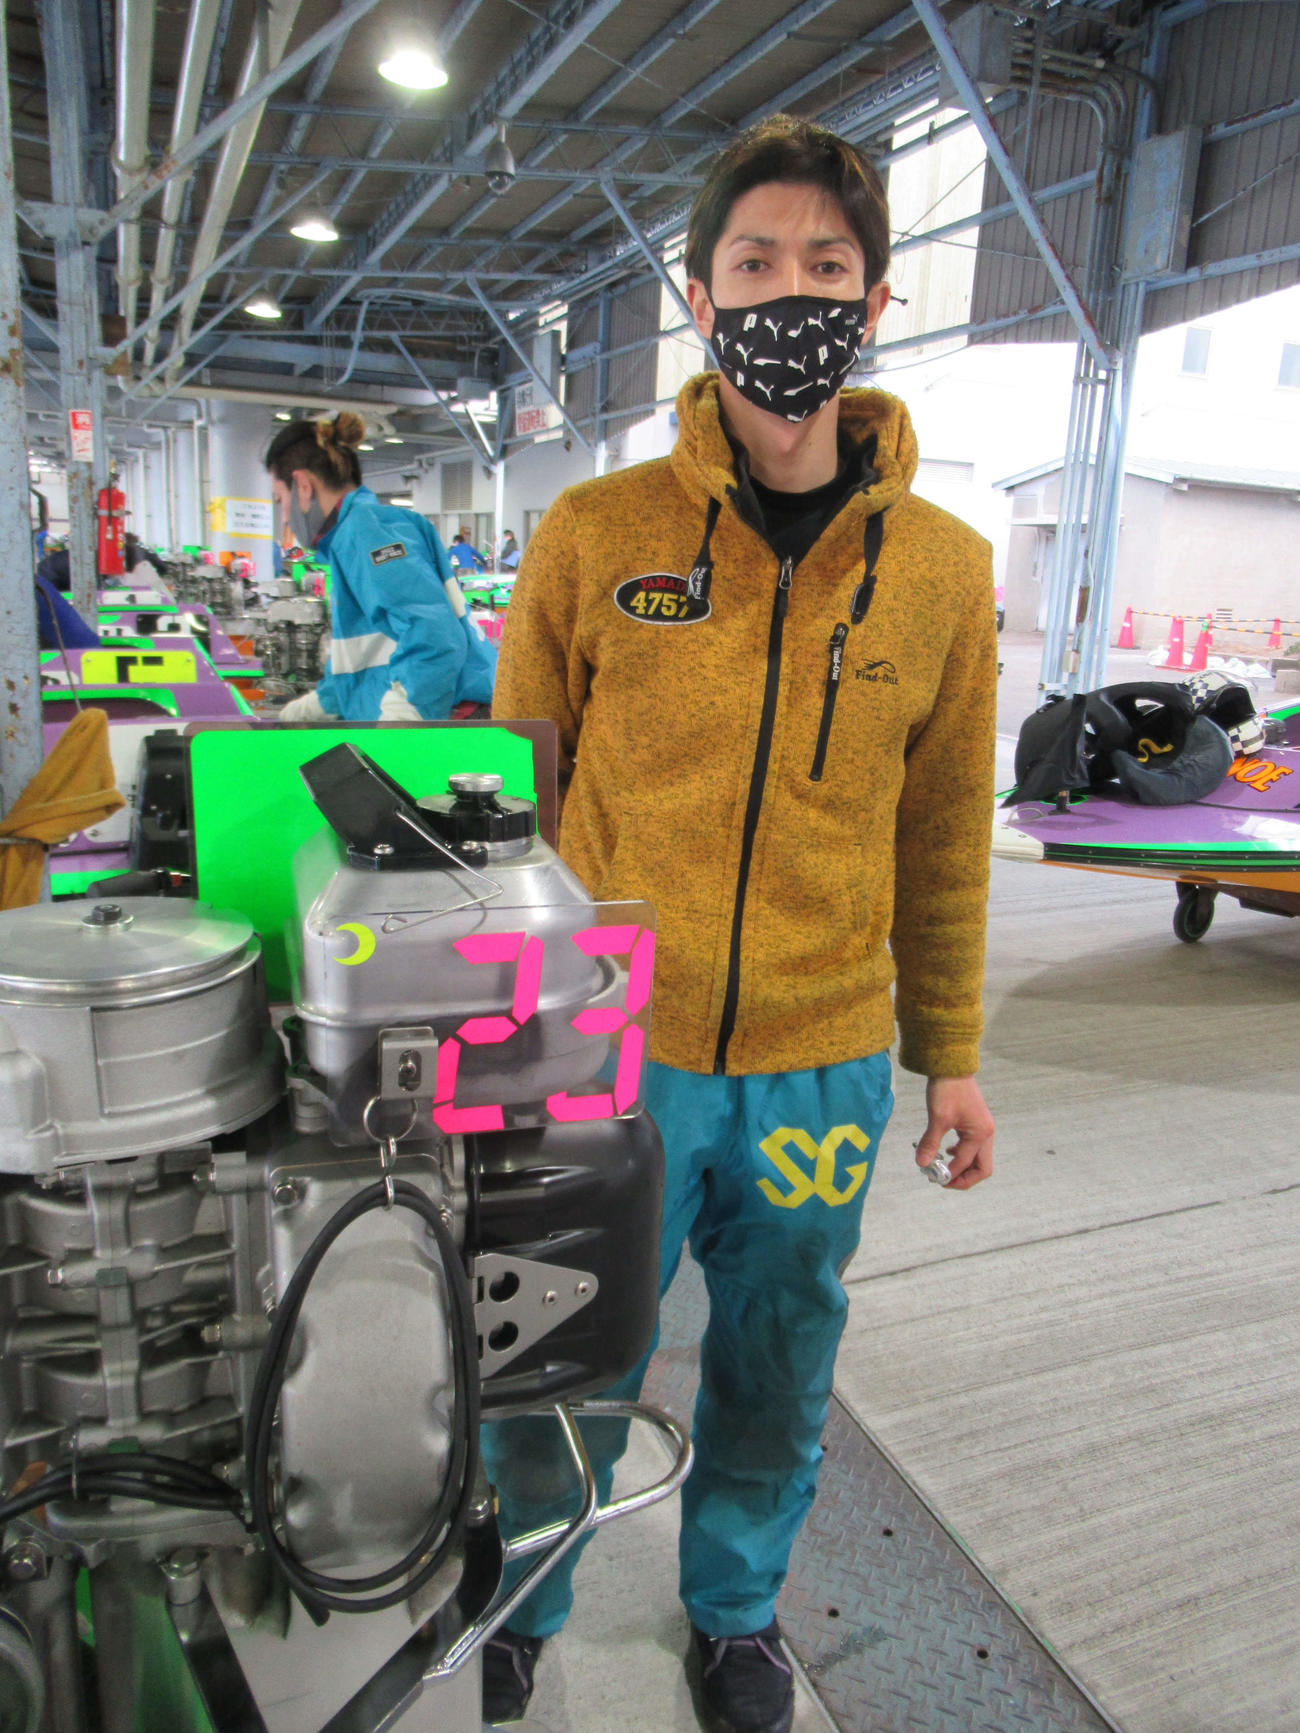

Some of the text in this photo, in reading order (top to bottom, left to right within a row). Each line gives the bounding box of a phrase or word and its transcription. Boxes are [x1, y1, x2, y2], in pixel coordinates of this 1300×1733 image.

[639, 577, 686, 592] YAMAD
[855, 669, 899, 686] Find-Out
[756, 1124, 871, 1209] SG
